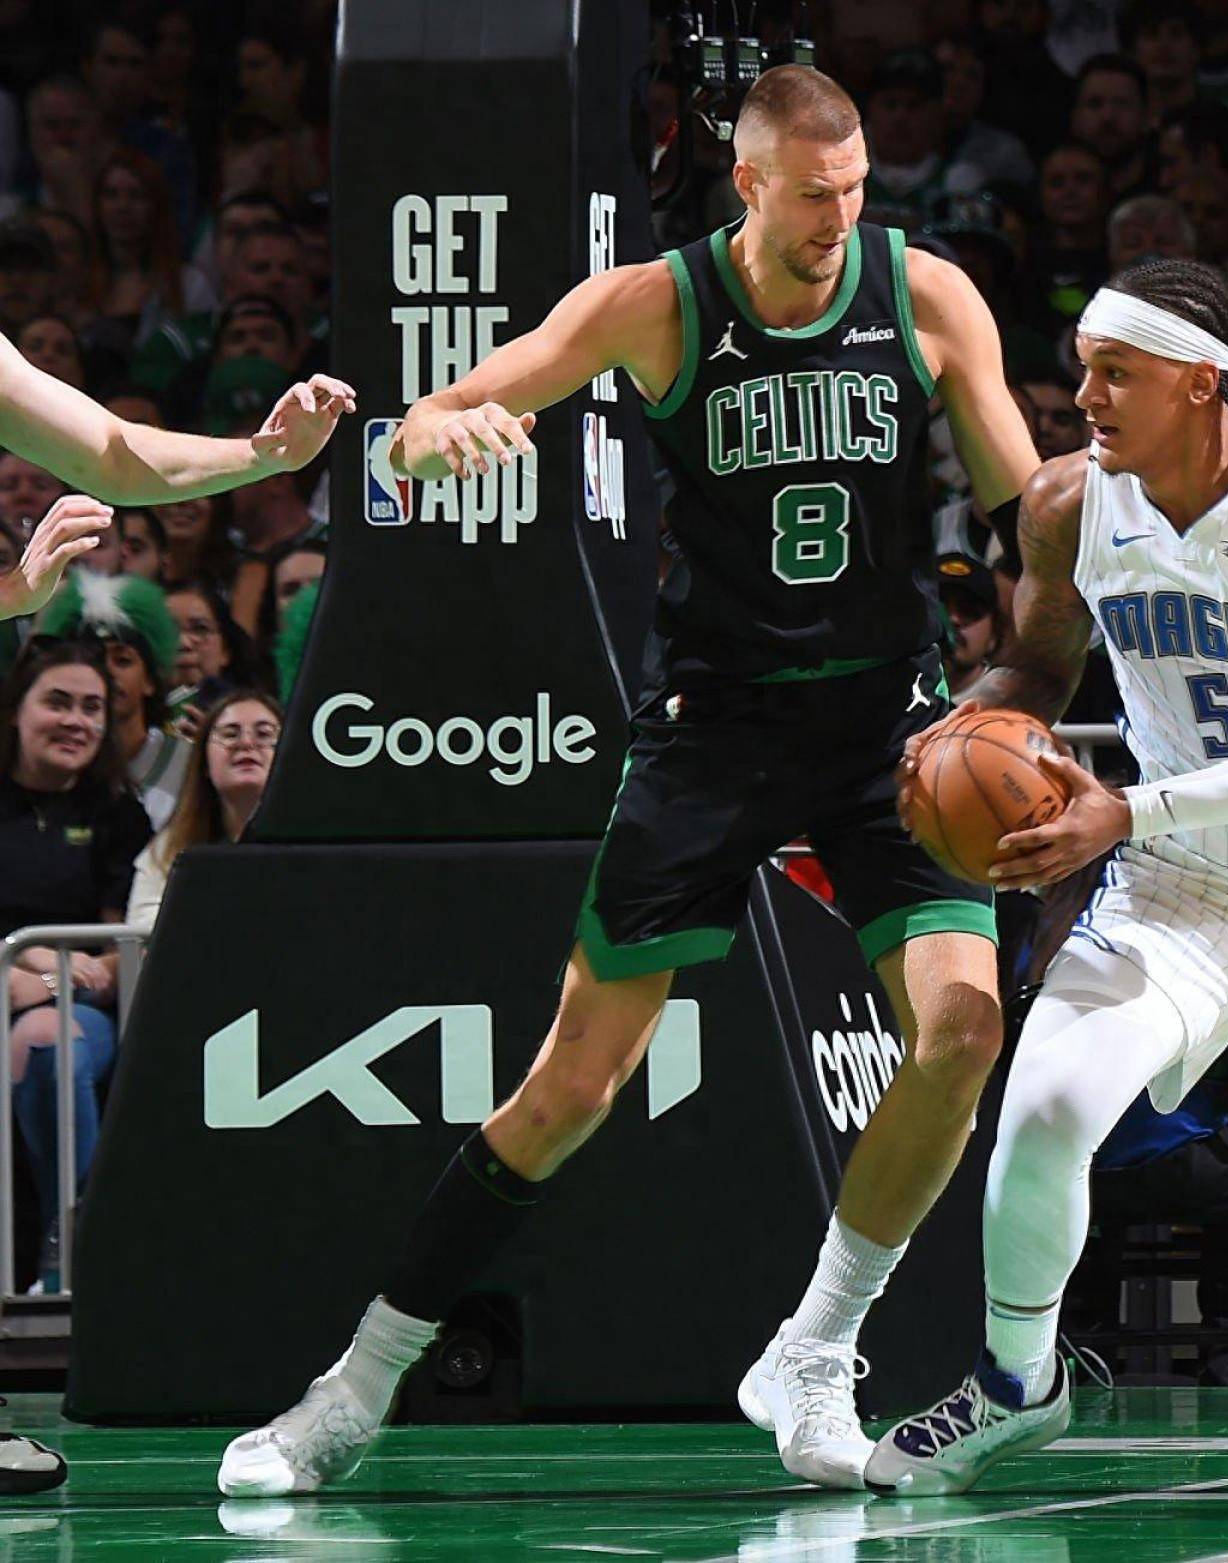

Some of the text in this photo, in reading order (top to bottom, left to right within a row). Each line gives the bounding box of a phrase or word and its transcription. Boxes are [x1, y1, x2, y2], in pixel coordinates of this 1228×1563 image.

[392, 194, 508, 295] GET
[841, 326, 895, 346] Amica
[705, 370, 898, 476] CELTICS
[771, 481, 850, 585] 8
[311, 692, 597, 787] Google
